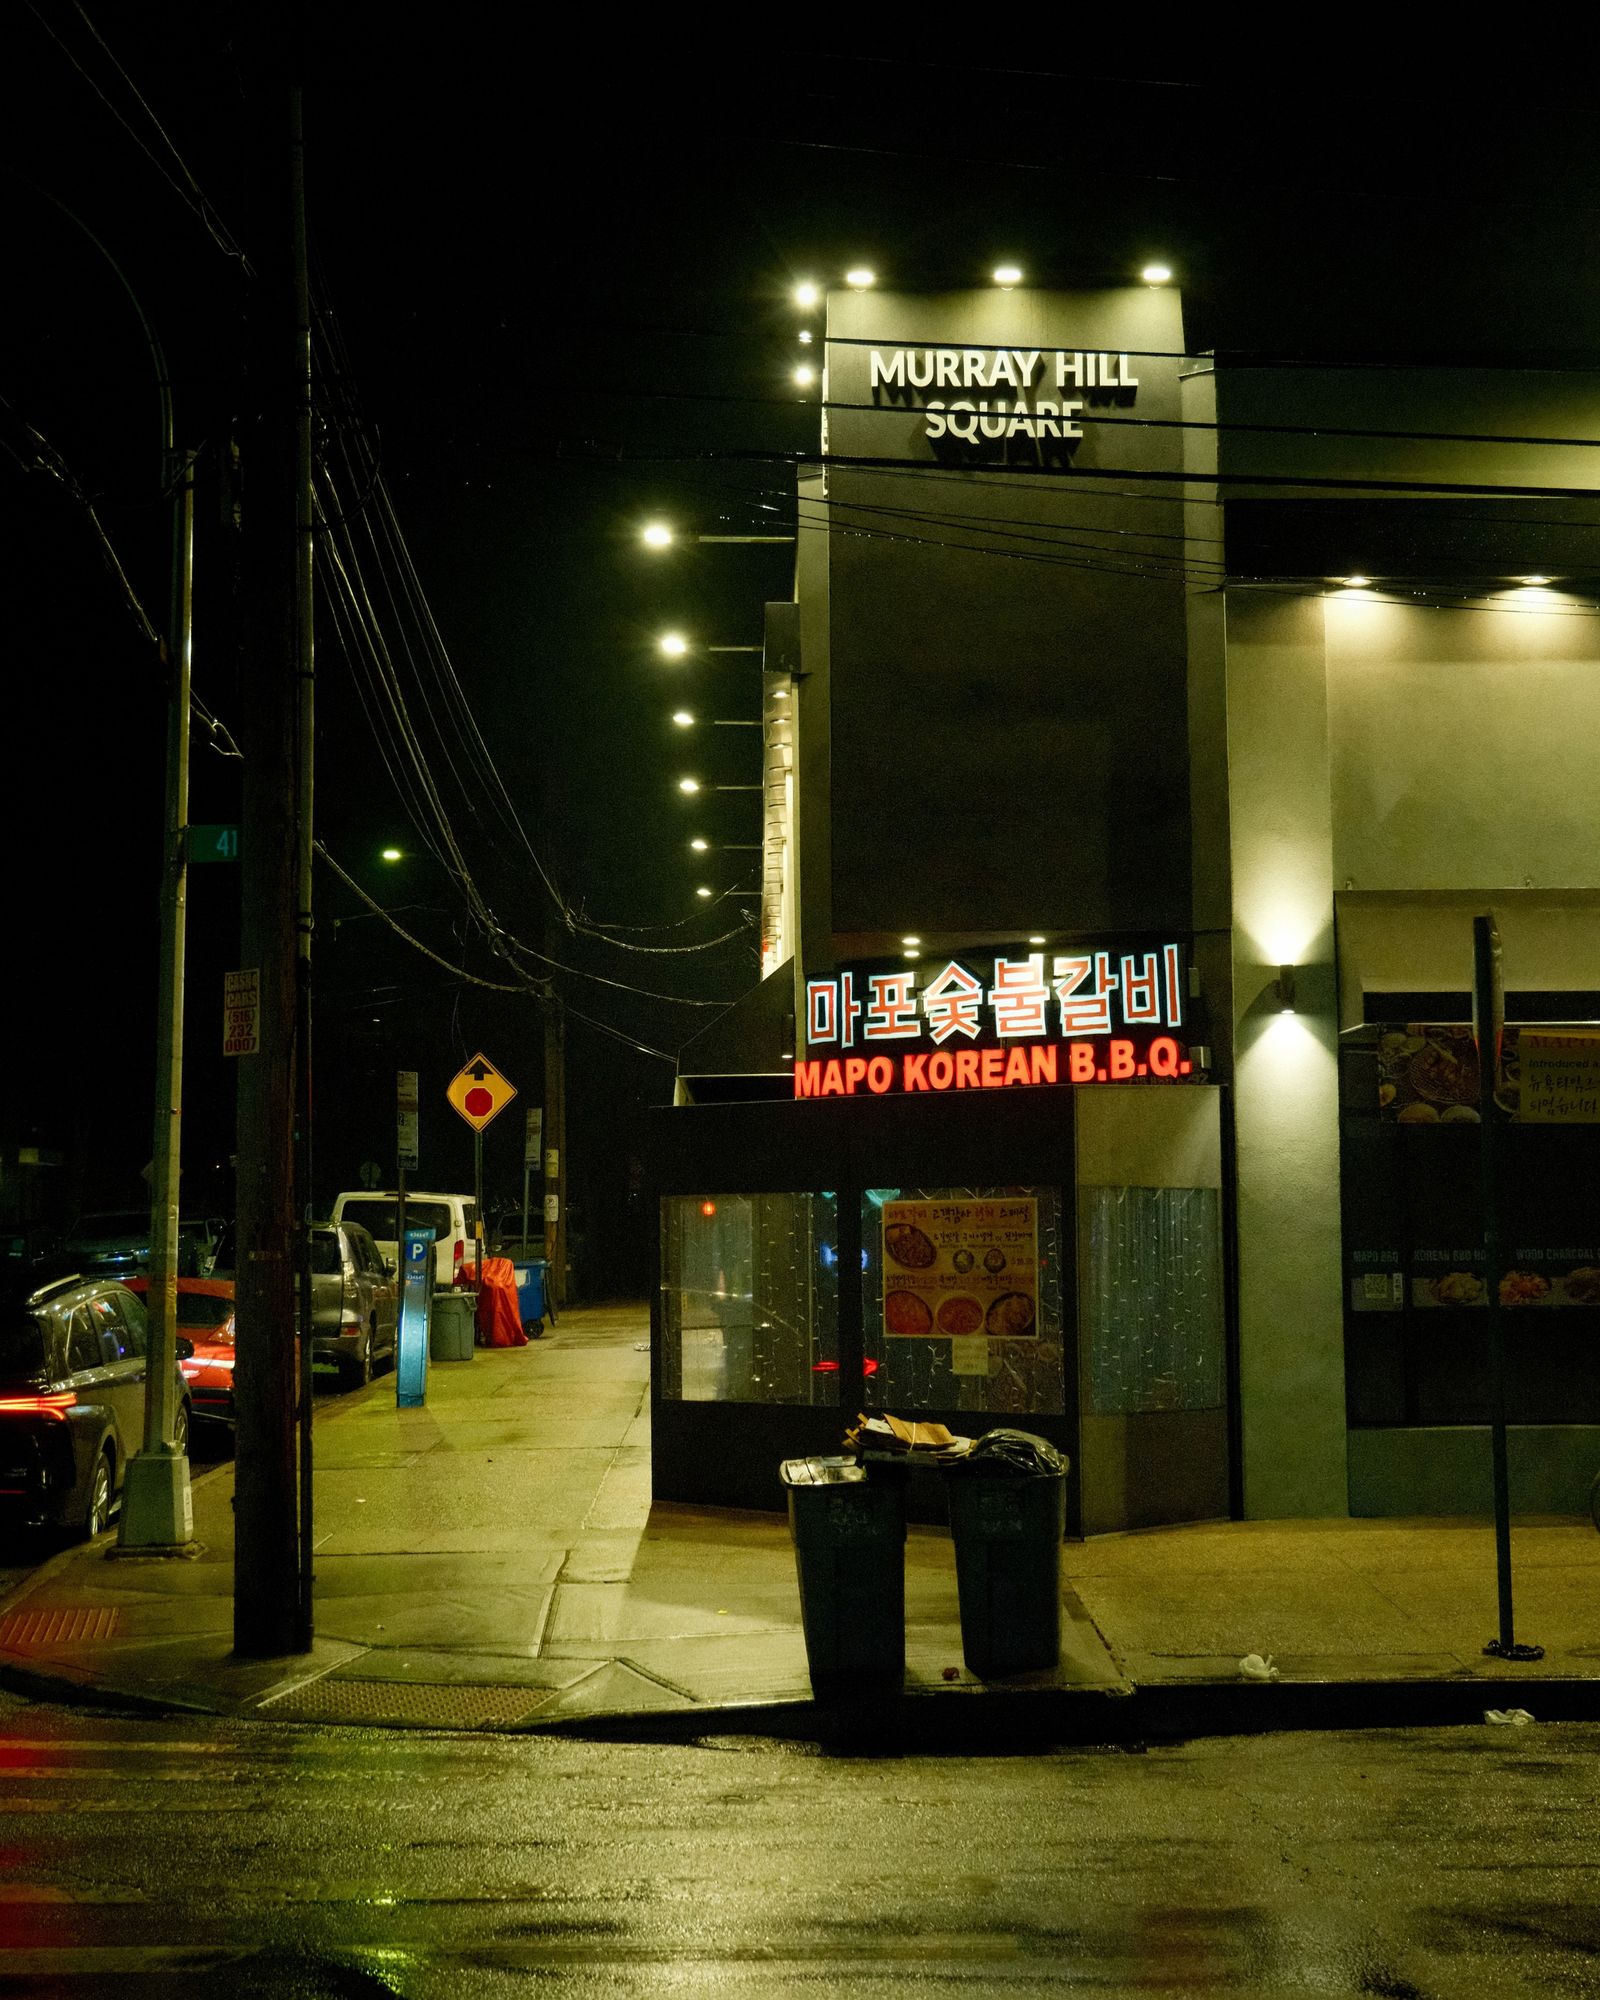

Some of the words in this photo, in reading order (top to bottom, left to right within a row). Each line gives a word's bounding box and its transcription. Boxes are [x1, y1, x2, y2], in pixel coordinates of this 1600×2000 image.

[870, 350, 1040, 388] MURRAY
[1056, 352, 1139, 387] HILL
[925, 401, 1083, 444] SQUARE
[216, 830, 238, 856] 41
[227, 991, 256, 1008] CARS
[807, 943, 1182, 1048] 마포숯불갈비
[796, 1056, 894, 1098] MAPO
[903, 1046, 1057, 1093] KOREAN
[1070, 1037, 1192, 1083] B.B.Q.
[412, 1243, 424, 1260] P
